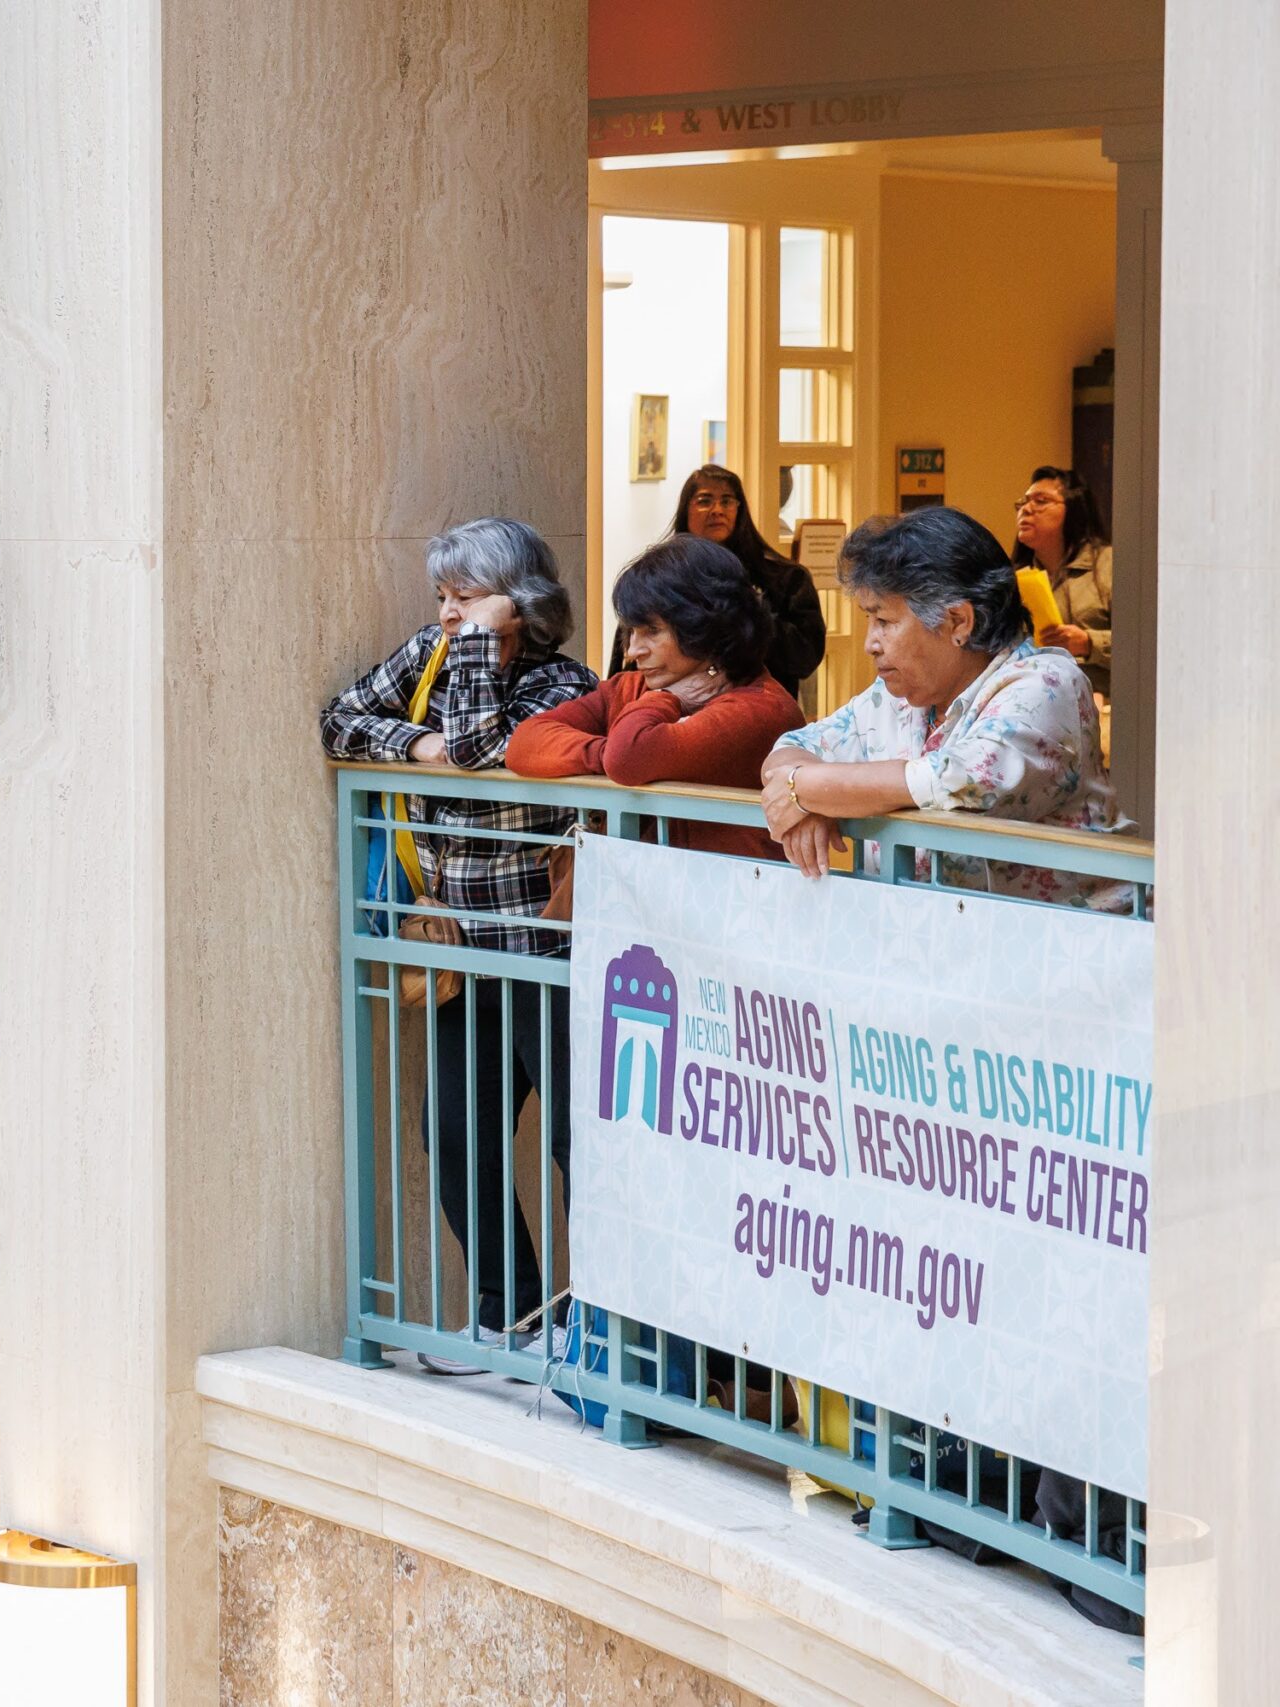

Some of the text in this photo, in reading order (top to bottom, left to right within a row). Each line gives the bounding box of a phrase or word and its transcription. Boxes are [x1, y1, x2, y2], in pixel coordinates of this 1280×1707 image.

[681, 108, 700, 133] &
[717, 102, 795, 131] WEST
[809, 96, 902, 126] LOBBY
[685, 1013, 731, 1058] MEXICO
[699, 977, 726, 1015] NEW
[734, 985, 827, 1083] AGING
[680, 1061, 836, 1177] SERVICES
[849, 1023, 1153, 1156] AGING & DISABILITY
[853, 1103, 1149, 1255] RESOURCE CENTER
[733, 1184, 985, 1331] aging.nm.gov
